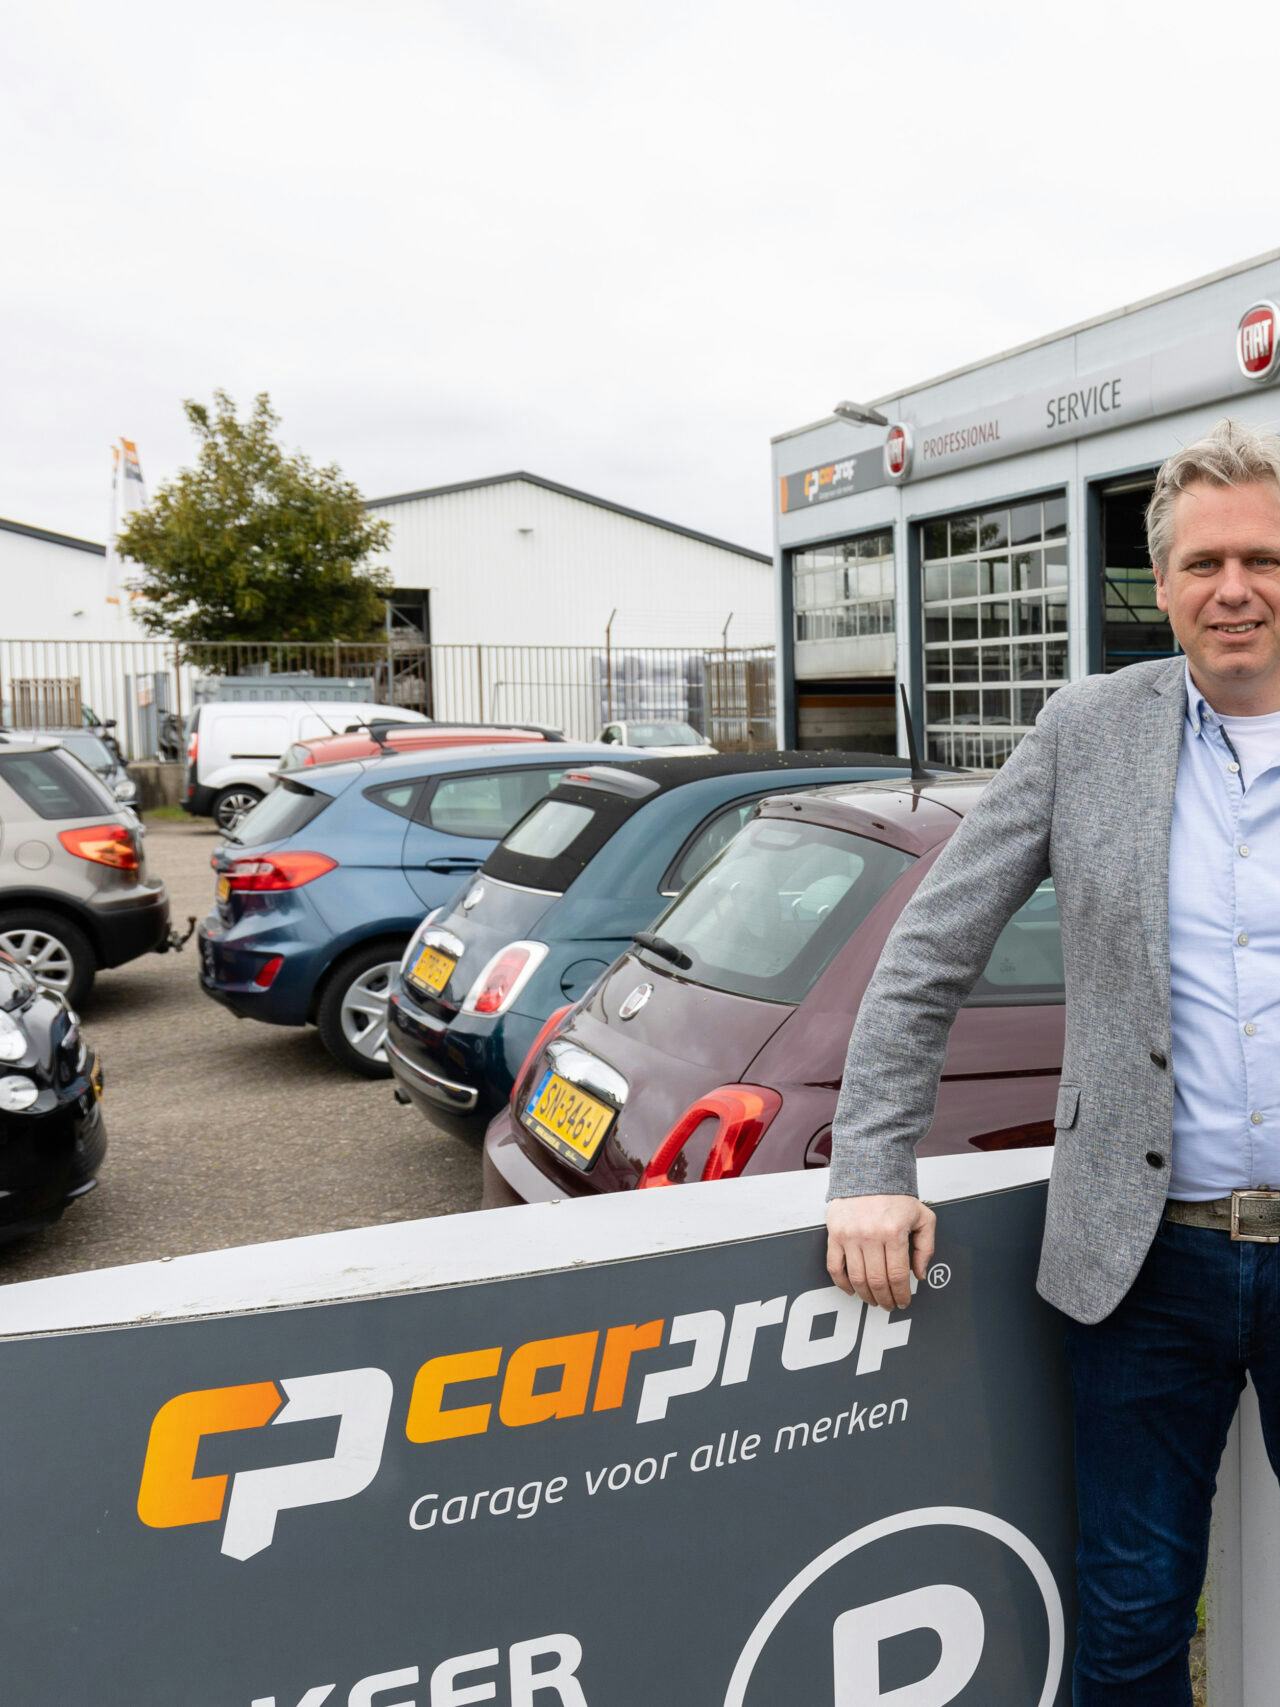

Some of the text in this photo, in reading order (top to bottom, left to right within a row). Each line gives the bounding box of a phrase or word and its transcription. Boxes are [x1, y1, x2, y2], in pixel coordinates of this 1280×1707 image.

[1243, 318, 1272, 362] FIAT
[922, 378, 1122, 461] PROFESSIONAL SERVICE
[408, 1398, 909, 1531] Garage voor alle merken
